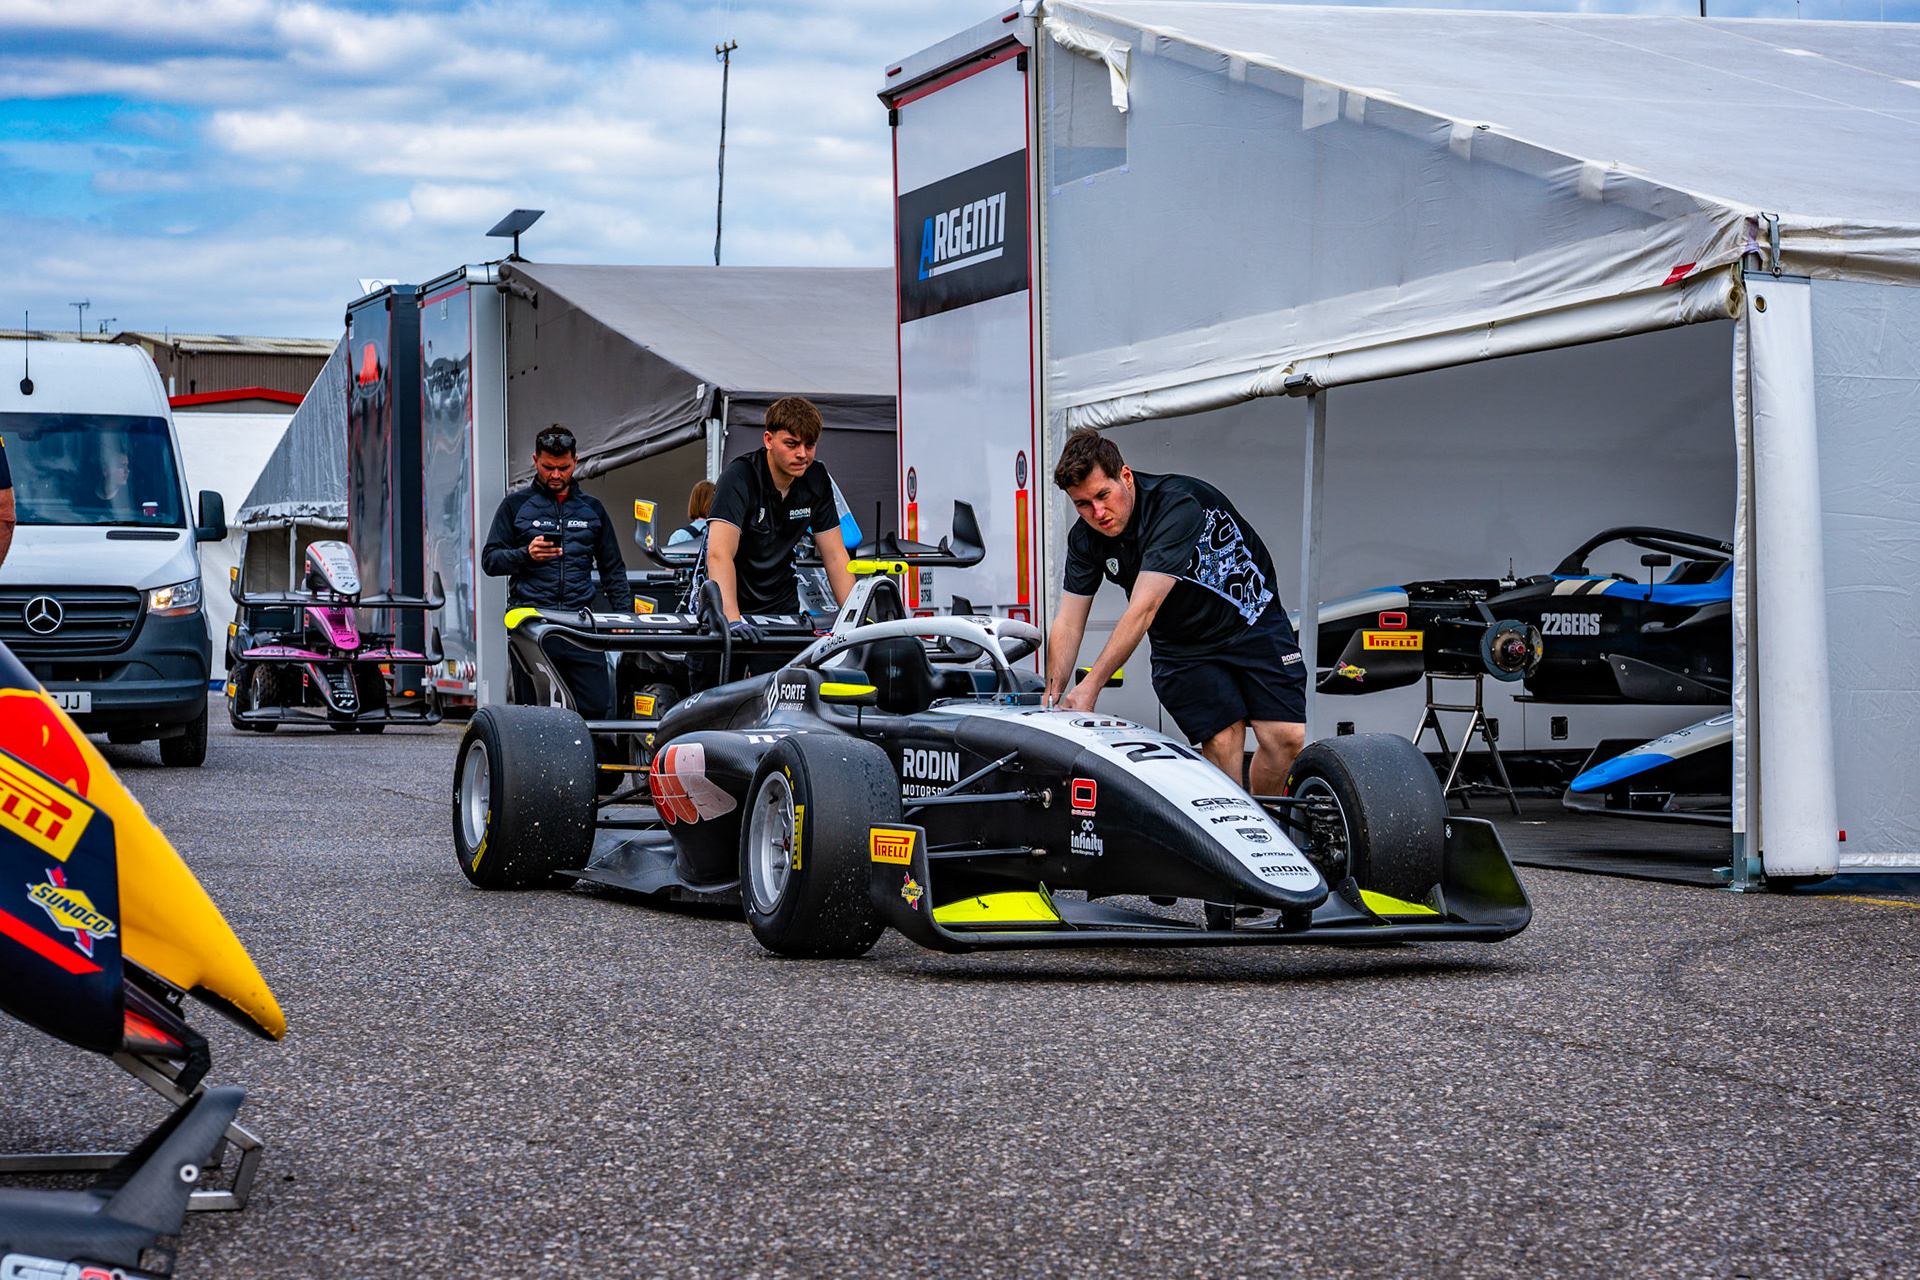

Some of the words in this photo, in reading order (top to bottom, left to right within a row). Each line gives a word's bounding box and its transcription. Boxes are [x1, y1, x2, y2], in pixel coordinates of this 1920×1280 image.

[918, 191, 1007, 281] ARGENTI
[790, 508, 811, 517] RODIN
[1540, 612, 1600, 636] 226ERS
[1368, 634, 1418, 647] PIRELLI
[780, 684, 807, 700] FORTE
[1111, 742, 1202, 763] 21
[903, 748, 960, 782] RODIN
[1210, 815, 1249, 825] MSV
[873, 834, 910, 858] PIRELLI
[1070, 830, 1104, 857] infinity
[1259, 865, 1310, 874] RODIN
[34, 885, 109, 932] SUNOCO
